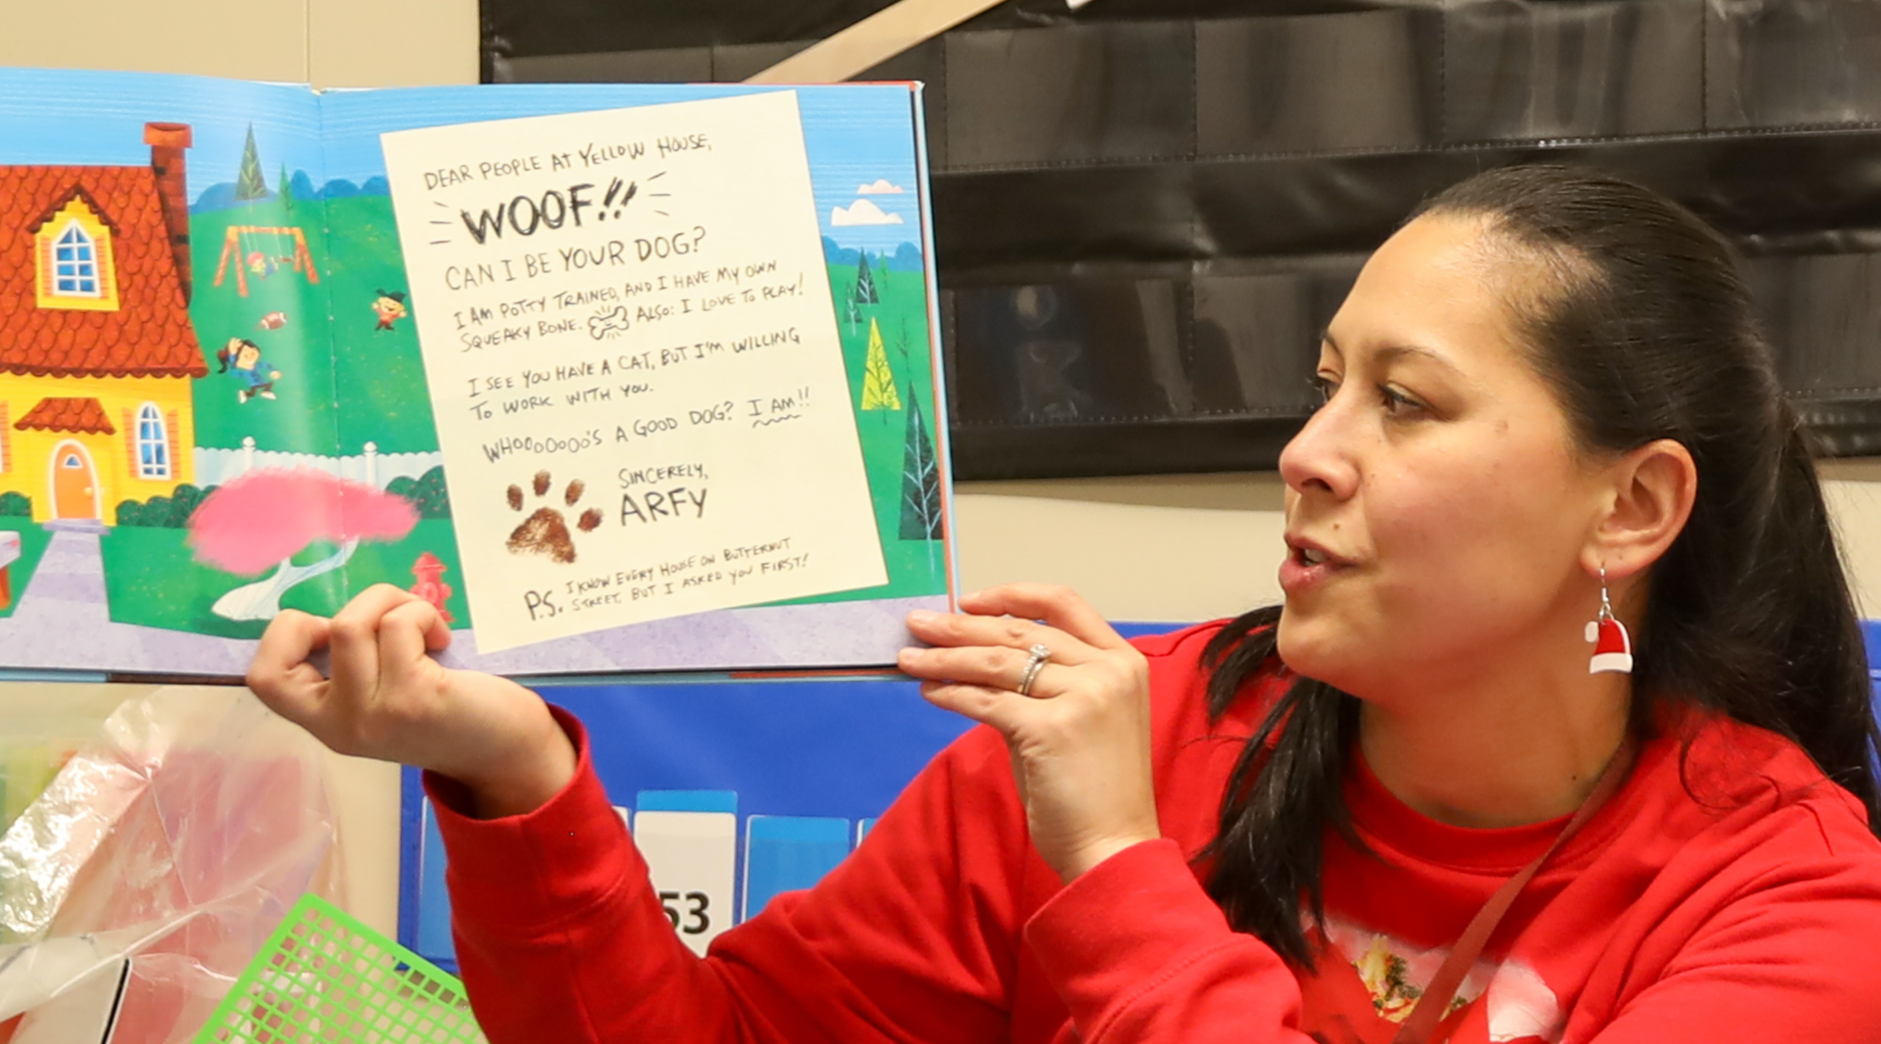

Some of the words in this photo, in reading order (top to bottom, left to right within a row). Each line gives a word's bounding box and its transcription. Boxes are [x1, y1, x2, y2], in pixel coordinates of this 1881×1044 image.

[424, 164, 474, 190] DEAR
[479, 156, 542, 180] PEOPLE
[551, 152, 572, 172] AT
[578, 142, 645, 167] YELLOW
[657, 133, 712, 159] HOUSE,
[460, 176, 638, 245] WOOF!!
[445, 264, 494, 290] CAN
[501, 259, 516, 282] I
[524, 253, 551, 278] BE
[558, 240, 625, 271] YOUR
[634, 225, 706, 262] DOG?
[454, 312, 466, 330] I
[470, 307, 493, 326] AM
[553, 287, 620, 309] TRAINED,
[625, 282, 652, 297] AND
[658, 275, 669, 291] I
[673, 270, 710, 288] HAVE
[717, 266, 739, 286] MY
[745, 260, 777, 277] OWN
[460, 326, 530, 352] SQUEAKY
[537, 318, 583, 336] BONE.
[682, 298, 692, 314] I
[702, 293, 736, 311] LOVE
[762, 272, 804, 300] PLAY!
[468, 377, 481, 398] I
[486, 376, 514, 391] SEE
[522, 369, 550, 388] YOU
[555, 361, 594, 381] HAVE
[601, 359, 612, 375] A
[618, 351, 655, 370] CAT,
[661, 346, 688, 366] BUT
[694, 341, 725, 359] I'M
[731, 326, 801, 353] WILLING
[503, 396, 554, 414] WORK
[566, 387, 612, 406] WITH
[616, 425, 629, 443] A
[633, 417, 678, 437] GOOD
[688, 400, 734, 425] DOG?
[747, 399, 763, 416] I
[770, 386, 810, 413] AM!!
[618, 463, 709, 489] SINCERELY,
[620, 486, 707, 526] ARFY
[524, 590, 563, 621] P.S.
[566, 581, 575, 595] I
[577, 576, 610, 595] KNOW
[616, 567, 653, 586] EVERY
[659, 555, 697, 577] HOUSE
[701, 554, 716, 567] ON
[723, 537, 791, 562] BUTTERNUT
[631, 584, 656, 601] BUT
[664, 582, 674, 595] I
[682, 571, 723, 588] ASKED
[729, 565, 753, 585] YOU
[760, 552, 809, 575] FIRST!
[659, 891, 710, 935] 53
